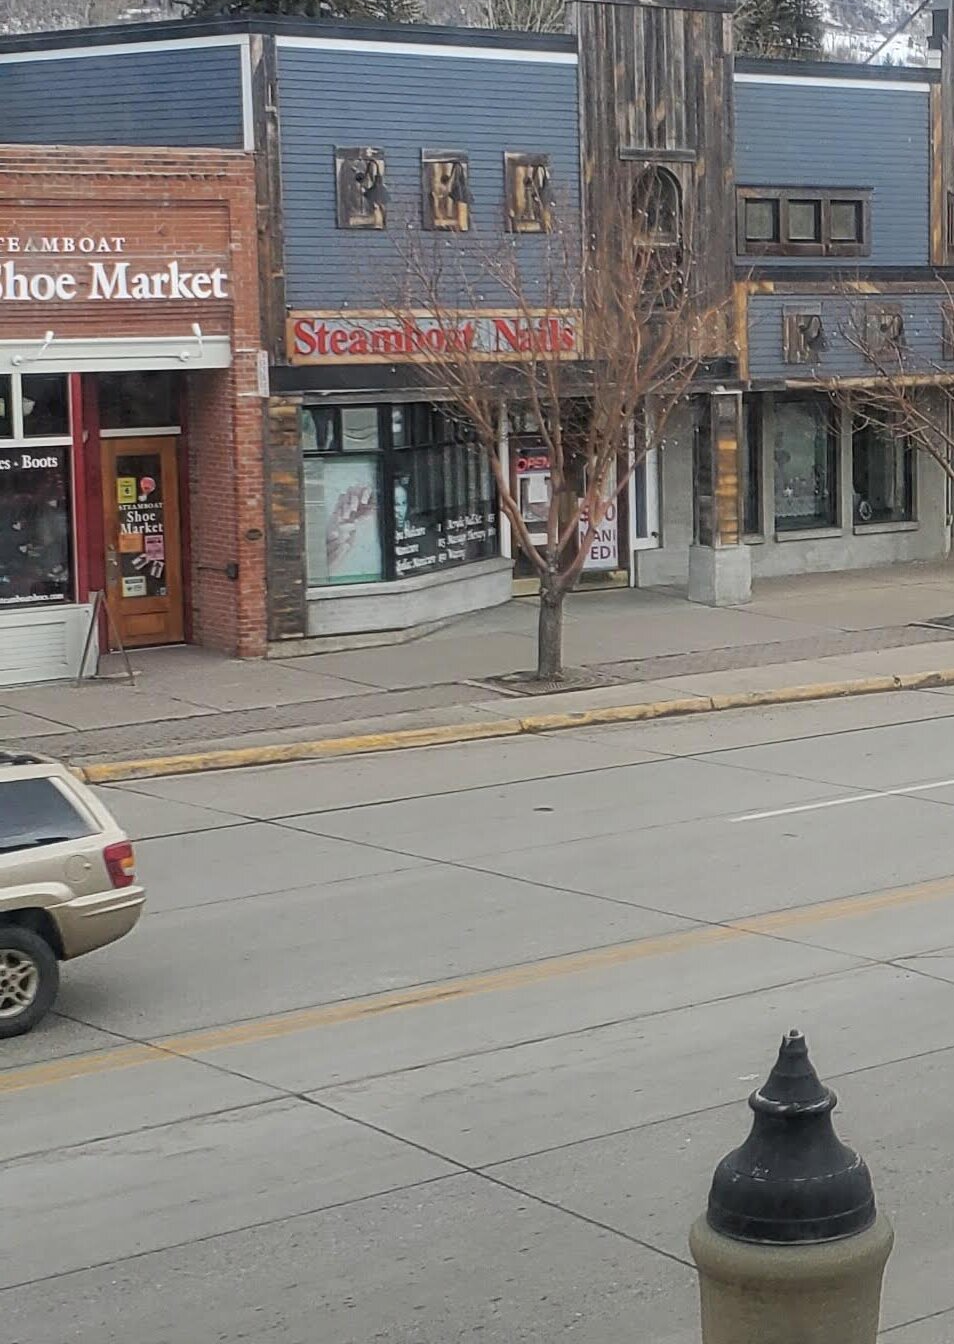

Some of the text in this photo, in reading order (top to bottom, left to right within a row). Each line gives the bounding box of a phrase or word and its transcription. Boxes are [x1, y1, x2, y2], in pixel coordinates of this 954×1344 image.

[0, 260, 228, 301] hoe Market
[492, 318, 576, 353] Nails
[22, 455, 58, 469] Boots
[118, 502, 163, 511] STEAMBOAT
[126, 511, 156, 523] Shoe
[120, 522, 163, 535] Market
[590, 545, 616, 561] EDI
